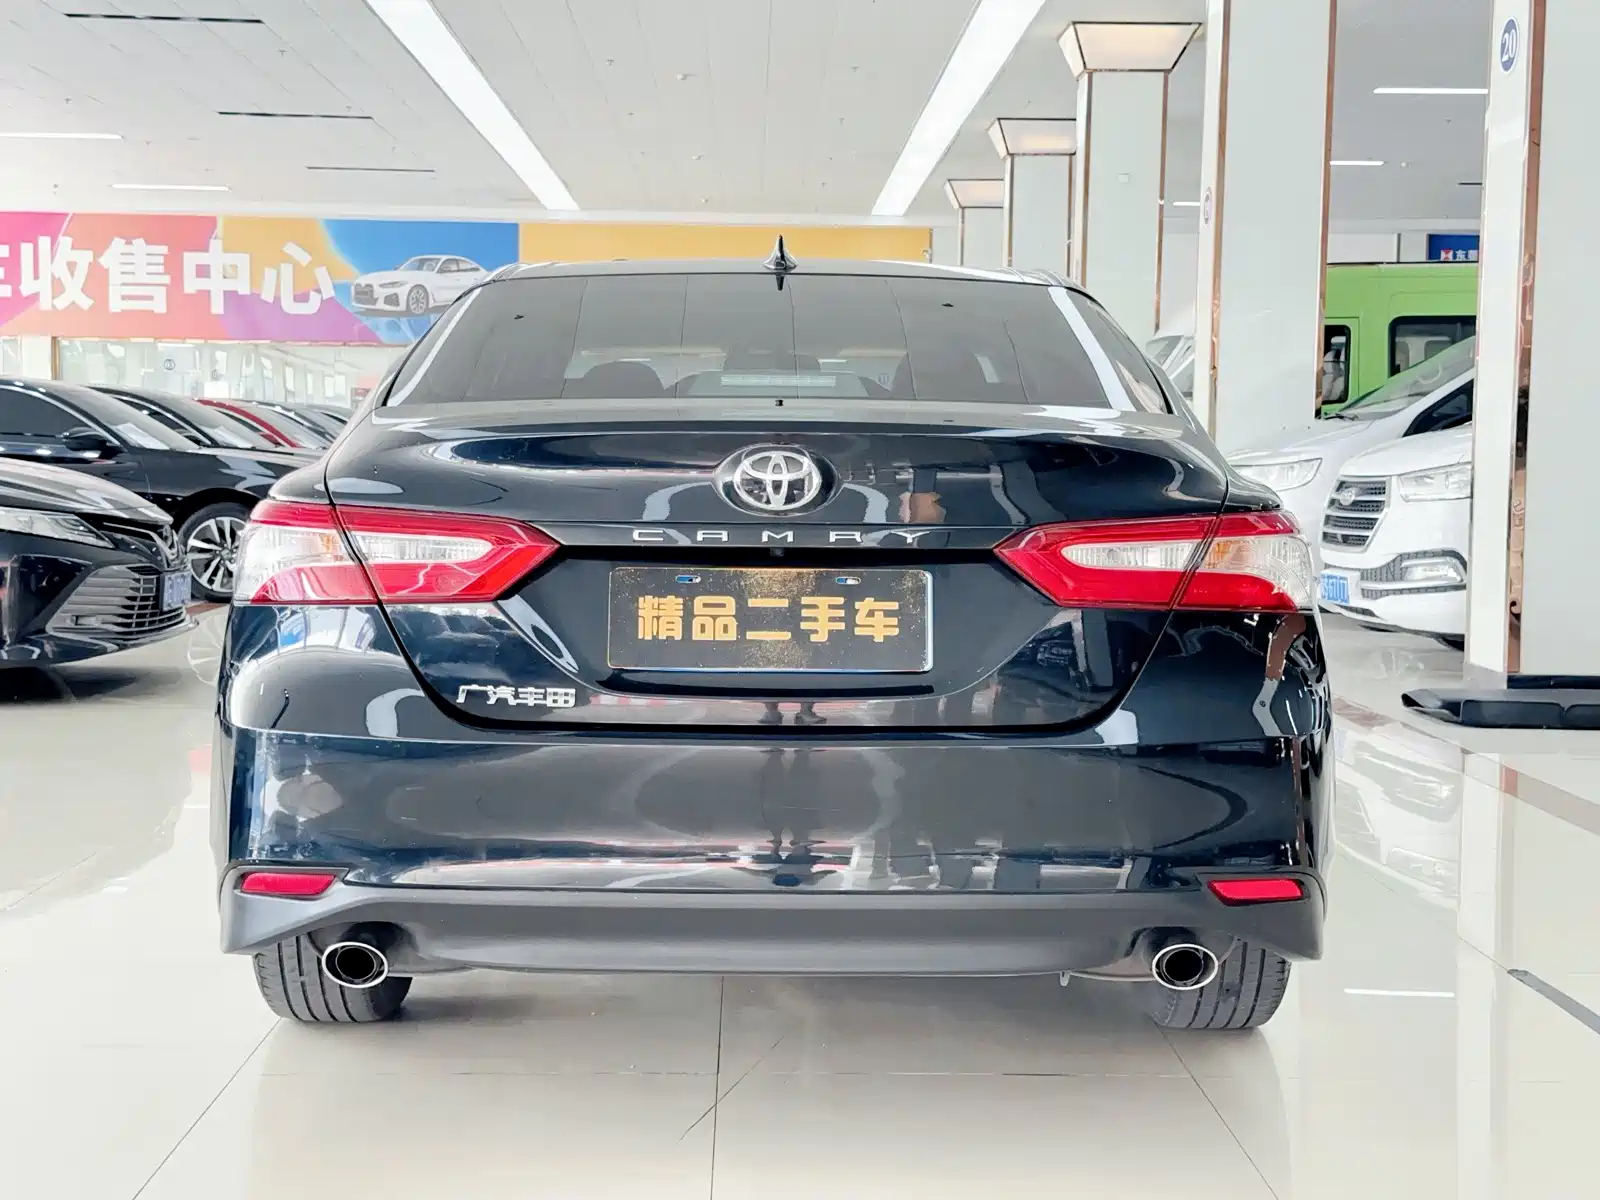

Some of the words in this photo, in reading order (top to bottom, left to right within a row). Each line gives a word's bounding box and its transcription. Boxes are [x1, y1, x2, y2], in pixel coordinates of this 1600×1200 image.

[1502, 28, 1516, 62] 20
[0, 235, 336, 315] 收售中心
[632, 529, 930, 543] CAMRY
[637, 595, 900, 643] 精品二手车
[456, 684, 576, 708] 广汽丰田
